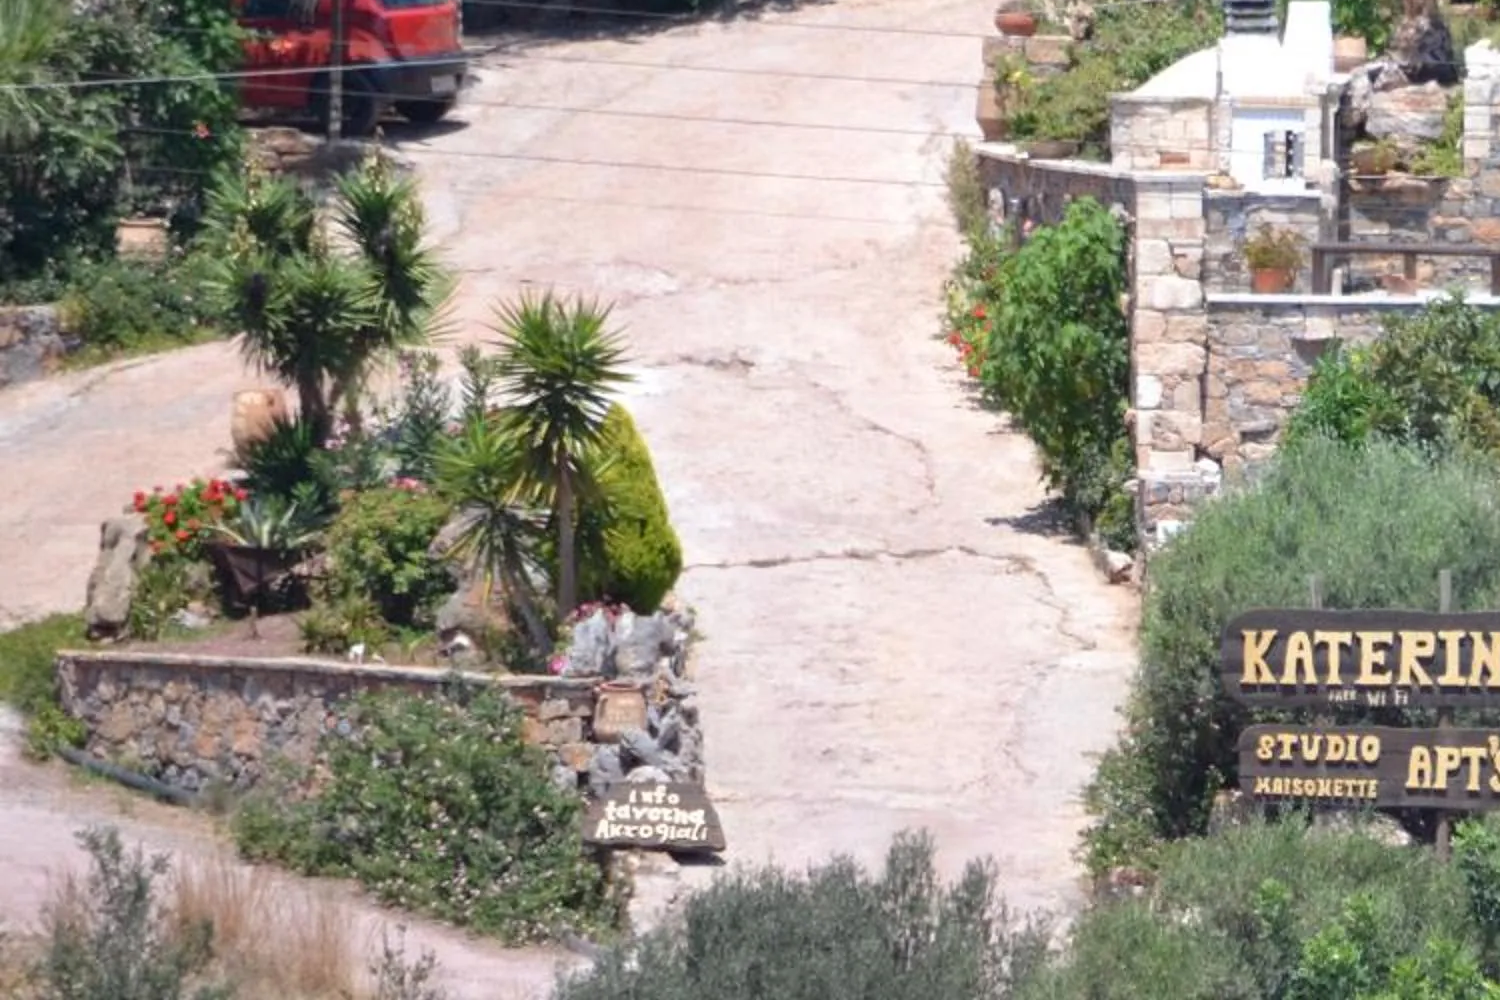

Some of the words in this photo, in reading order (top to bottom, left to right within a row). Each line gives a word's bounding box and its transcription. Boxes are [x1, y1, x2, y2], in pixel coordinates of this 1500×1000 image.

[1256, 733, 1381, 763] STUDIO
[1254, 776, 1378, 799] MAISONETTE
[605, 800, 706, 825] taverna
